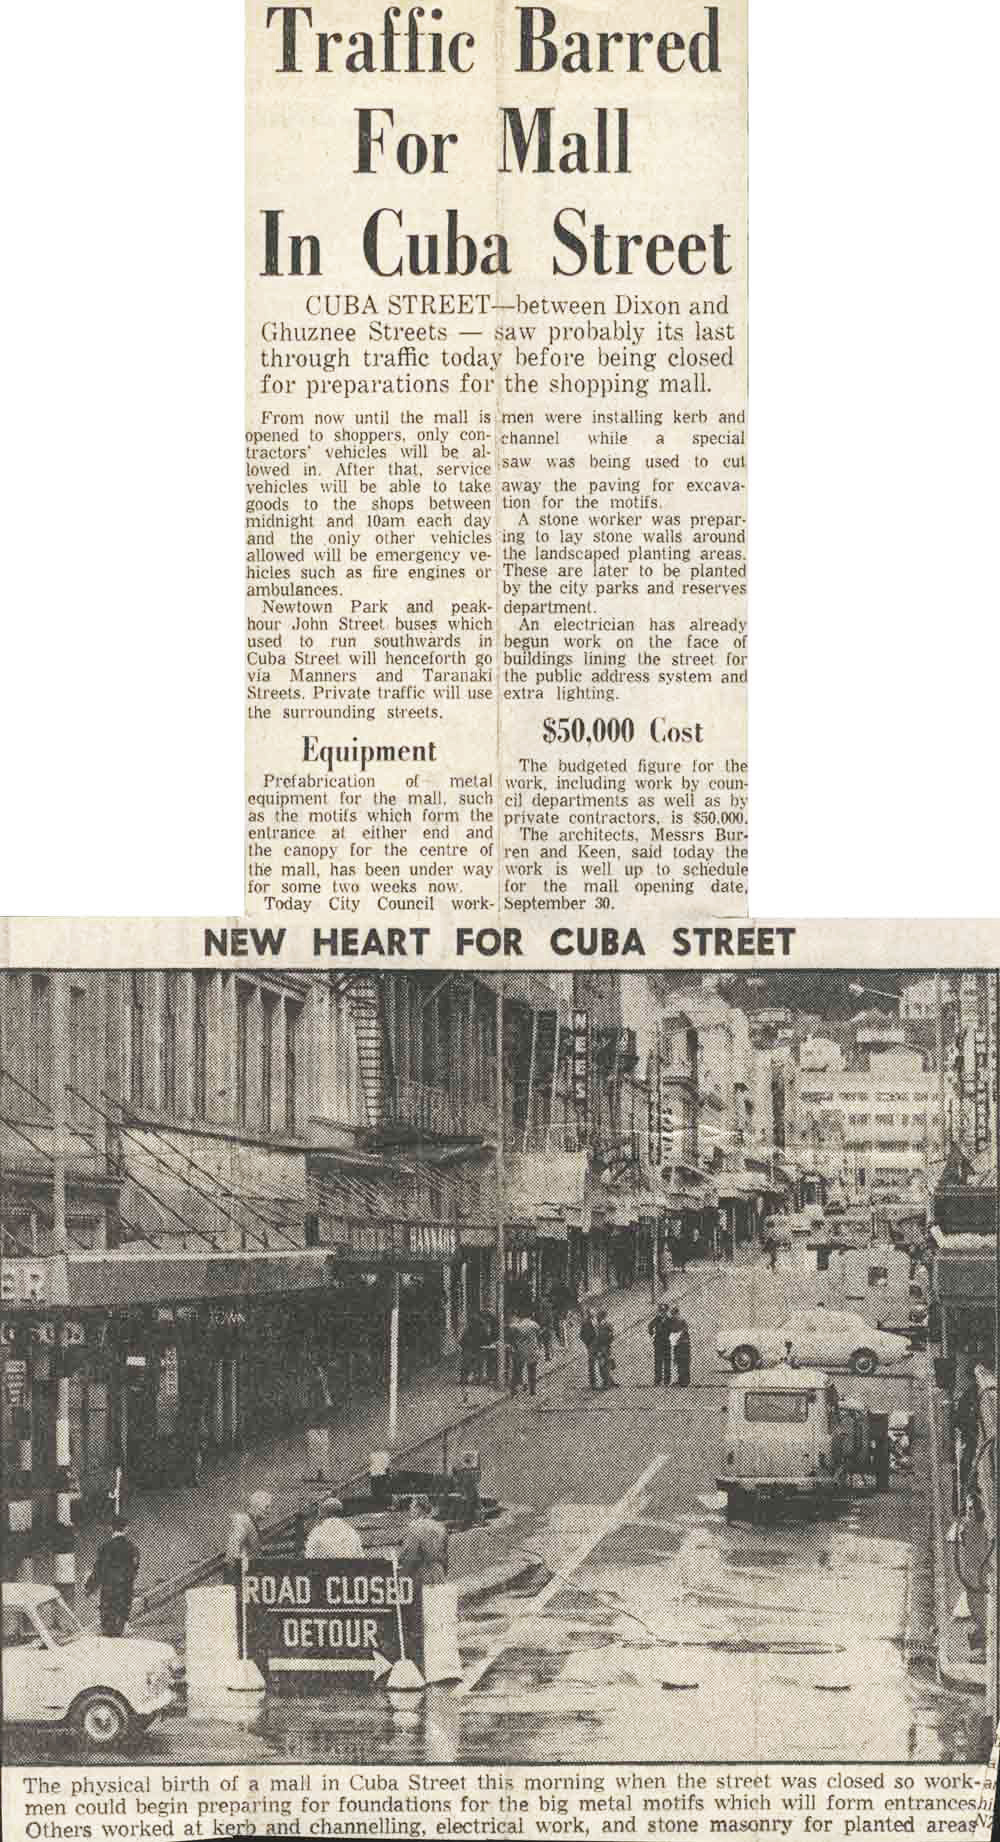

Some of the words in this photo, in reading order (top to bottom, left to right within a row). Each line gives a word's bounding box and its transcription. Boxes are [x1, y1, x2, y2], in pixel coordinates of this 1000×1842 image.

[266, 7, 474, 72] Traffic
[515, 6, 722, 73] Barred
[353, 108, 458, 174] For
[498, 107, 631, 174] Mall
[260, 210, 322, 276] In
[363, 208, 512, 277] Cuba
[553, 208, 732, 276] Street
[306, 295, 378, 315] CUBA
[616, 295, 680, 315] Dixon
[689, 295, 728, 315] and
[262, 322, 355, 341] Ghuznee
[369, 321, 447, 341] Streets
[495, 327, 535, 340] saw
[549, 320, 644, 345] probably
[658, 321, 683, 341] its
[696, 321, 734, 341] last
[262, 348, 349, 371] through
[364, 347, 428, 367] traffic
[442, 346, 502, 371] today
[516, 346, 584, 366] before
[599, 346, 656, 370] being
[668, 346, 733, 367] closed
[261, 374, 295, 393] for
[307, 373, 448, 398] preparations
[460, 373, 494, 392] for
[505, 373, 538, 393] the
[550, 373, 648, 398] shopping
[263, 411, 303, 424] From
[315, 414, 344, 424] now
[356, 411, 388, 424] until
[401, 411, 423, 424] the
[434, 410, 467, 424] mall
[480, 410, 491, 423] is
[502, 432, 558, 444] channel
[589, 432, 627, 444] while
[656, 435, 664, 444] a
[693, 431, 744, 447] special
[246, 512, 312, 529] midnight
[327, 514, 353, 527] and
[368, 515, 404, 527] 10am
[417, 513, 451, 527] each
[464, 513, 489, 529] day
[519, 512, 528, 526] A
[539, 514, 578, 526] stone
[589, 512, 642, 526] worker
[652, 516, 680, 526] was
[504, 546, 526, 560] the
[536, 546, 619, 563] landscaped
[628, 546, 690, 563] planting
[264, 600, 332, 613] Newtown
[352, 600, 387, 613] Park
[407, 600, 432, 613] and
[520, 618, 539, 631] An
[554, 617, 634, 631] electrician
[650, 618, 675, 631] has
[690, 618, 746, 633] already
[247, 652, 285, 665] Cuba
[295, 652, 338, 665] Street
[349, 651, 375, 664] will
[386, 651, 465, 665] henceforth
[476, 654, 492, 667] go
[248, 706, 270, 718] the
[283, 705, 374, 720] surrounding
[650, 718, 703, 742] Cost
[303, 736, 436, 772] Equipment
[504, 811, 559, 826] private
[672, 810, 683, 824] is
[520, 827, 548, 841] The
[652, 828, 704, 841] Messrs
[264, 897, 311, 912] Today
[329, 896, 360, 912] City
[378, 896, 433, 910] Council
[505, 896, 586, 912] September
[205, 928, 286, 957] NEW
[314, 928, 430, 956] HEART
[456, 928, 523, 956] FOR
[550, 928, 645, 956] CUBA
[673, 927, 796, 956] STREET
[243, 1576, 311, 1604] ROAD
[326, 1576, 414, 1605] CLOSED
[283, 1619, 378, 1648] DETOUR
[23, 1776, 60, 1792] The
[72, 1776, 149, 1796] physical
[163, 1776, 208, 1792] birth
[221, 1775, 235, 1791] of
[249, 1779, 258, 1791] a
[272, 1775, 309, 1791] mall
[323, 1775, 338, 1791] in
[350, 1775, 397, 1791] Cuba
[409, 1774, 464, 1790] Street
[478, 1773, 513, 1789] this
[525, 1773, 604, 1793] morning
[616, 1773, 664, 1789] when
[678, 1773, 706, 1789] the
[717, 1773, 768, 1789] street
[782, 1777, 816, 1789] was
[827, 1773, 883, 1789] closed
[895, 1777, 914, 1789] so
[925, 1773, 980, 1789] work-
[26, 1802, 65, 1814] men
[76, 1798, 125, 1814] could
[137, 1798, 186, 1818] begin
[198, 1797, 291, 1817] preparing
[302, 1797, 329, 1813] for
[340, 1796, 450, 1812] foundations
[462, 1796, 488, 1812] for
[500, 1795, 528, 1811] the
[540, 1795, 568, 1815] big
[580, 1795, 630, 1811] metal
[644, 1795, 704, 1811] motifs
[715, 1795, 770, 1811] which
[783, 1795, 814, 1811] will
[828, 1794, 872, 1810] form
[885, 1794, 976, 1810] entrances
[26, 1821, 91, 1837] Others
[102, 1820, 173, 1836] worked
[184, 1820, 200, 1836] at
[214, 1819, 256, 1835] kerb
[267, 1819, 300, 1835] and
[310, 1819, 425, 1839] channelling,
[437, 1818, 522, 1834] electrical
[536, 1817, 589, 1837] work,
[602, 1817, 635, 1833] and
[648, 1817, 698, 1833] stone
[711, 1821, 792, 1837] masonry
[805, 1817, 832, 1833] for
[845, 1817, 914, 1837] planted
